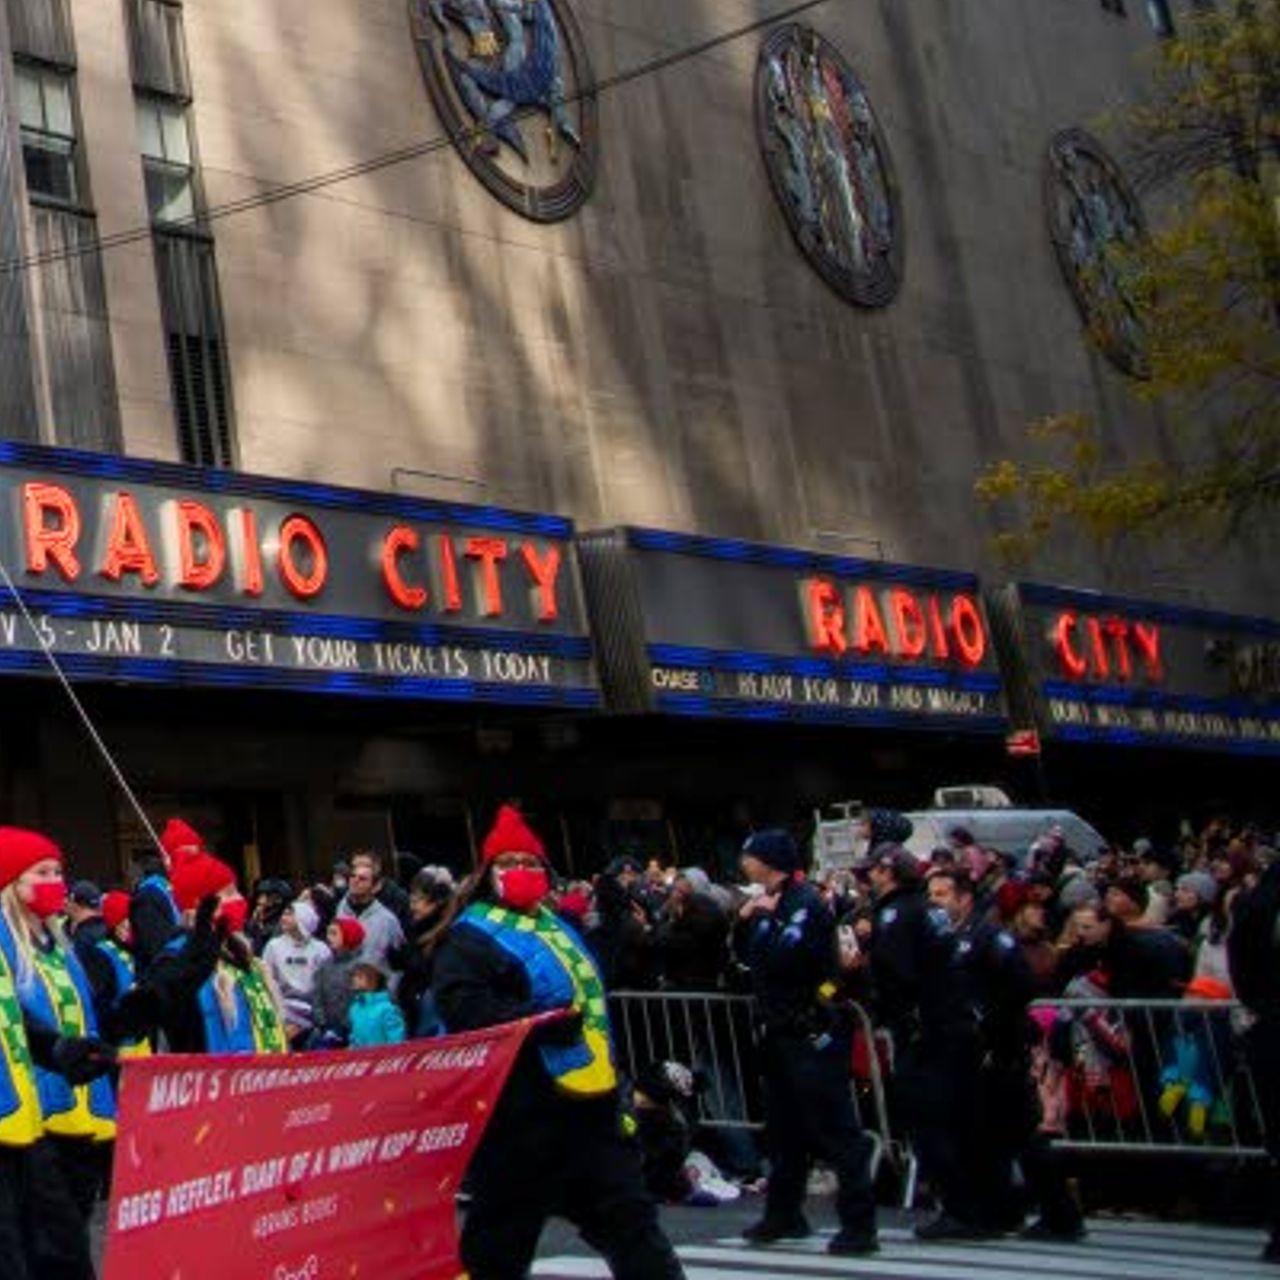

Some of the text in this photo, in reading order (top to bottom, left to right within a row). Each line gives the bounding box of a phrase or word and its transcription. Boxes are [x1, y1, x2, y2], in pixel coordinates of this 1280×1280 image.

[22, 480, 329, 599] RADIO
[381, 523, 562, 623] CITY
[40, 612, 57, 648] 5
[86, 621, 141, 654] JAN
[159, 624, 174, 655] 2
[226, 630, 274, 662] GET
[291, 635, 359, 669] YOUR
[372, 642, 469, 677] TICKETS
[482, 651, 552, 682] TODAY
[652, 669, 700, 690] CHASE
[807, 576, 987, 667] RADIO
[1055, 610, 1164, 681] CITY
[117, 1189, 162, 1231] GREG
[241, 1154, 286, 1194] DIARY
[289, 1151, 311, 1182] OF
[312, 1150, 324, 1177] A
[328, 1139, 381, 1173] WIMPY
[415, 1122, 470, 1153] SERIES
